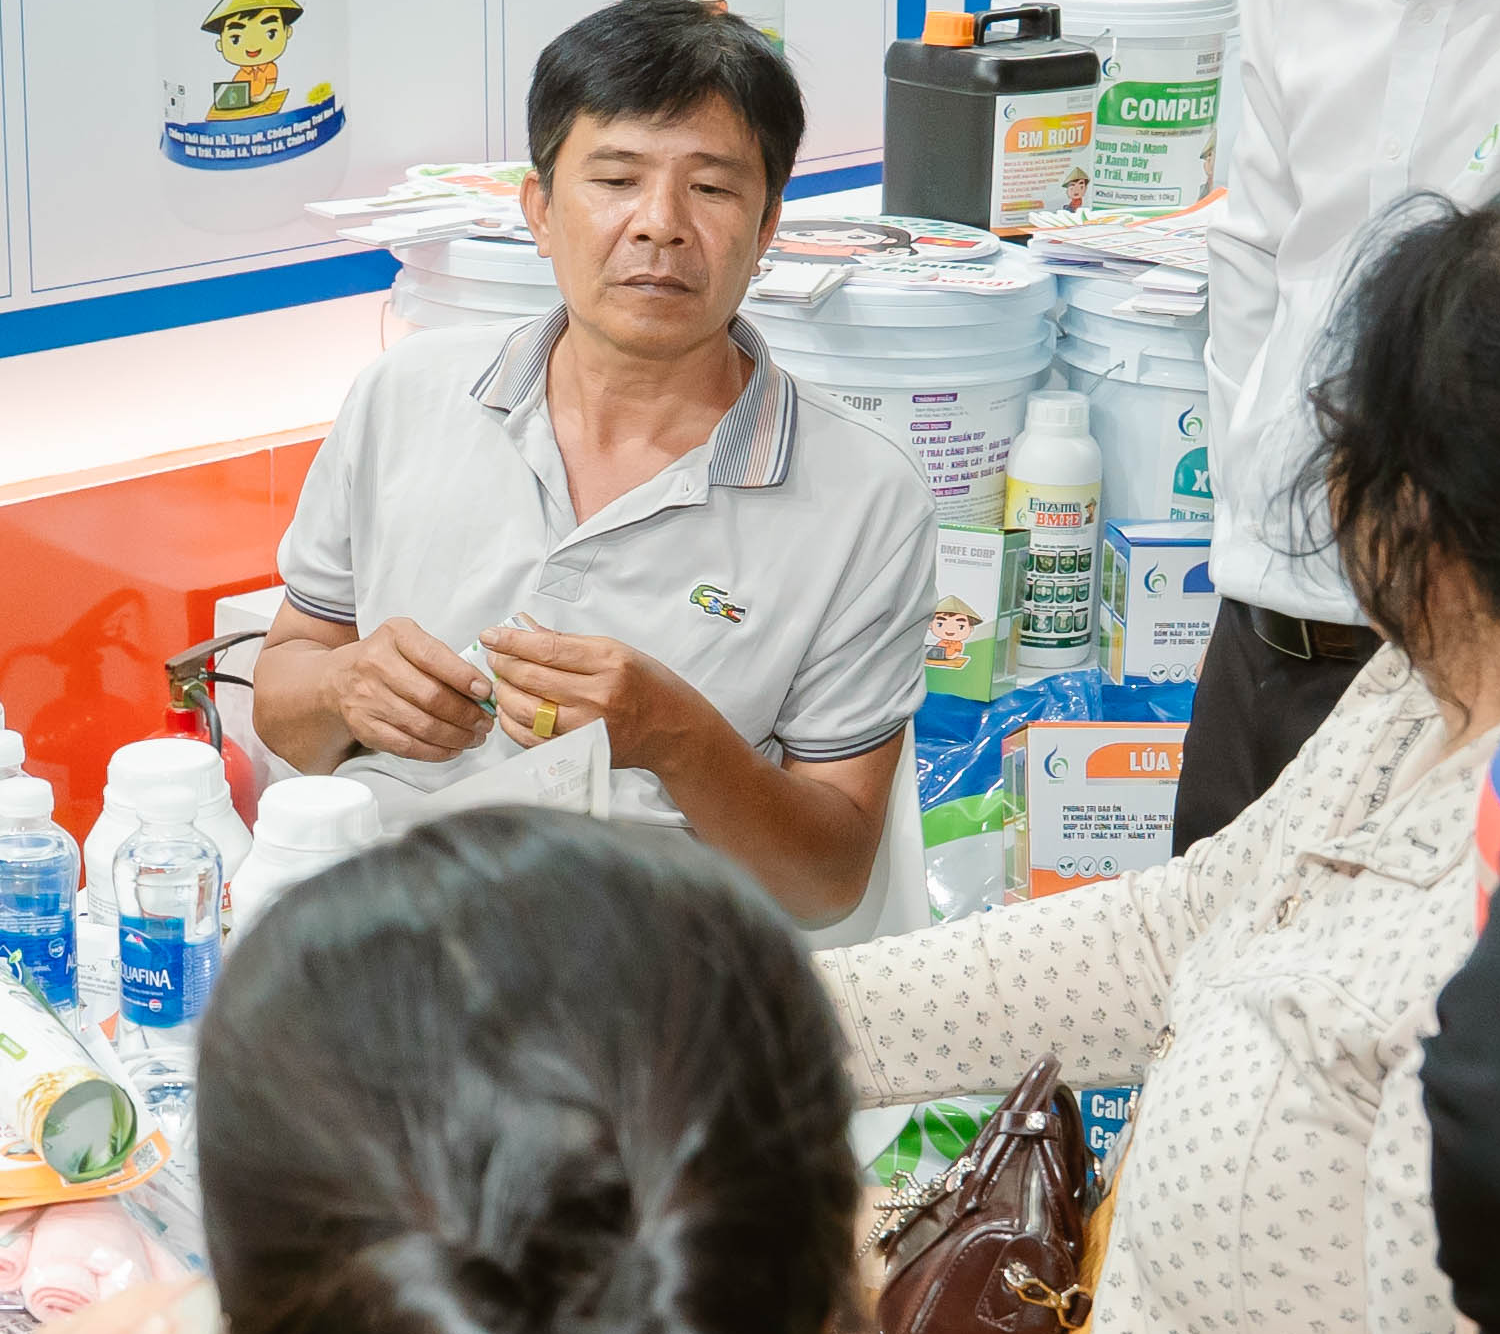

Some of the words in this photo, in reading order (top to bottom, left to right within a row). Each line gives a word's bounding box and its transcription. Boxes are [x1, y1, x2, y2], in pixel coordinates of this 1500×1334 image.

[1121, 96, 1216, 121] COMPLEX
[1018, 130, 1042, 148] BM
[1048, 126, 1084, 145] ROOT
[843, 395, 882, 411] CORP
[1130, 748, 1170, 771] LÚA
